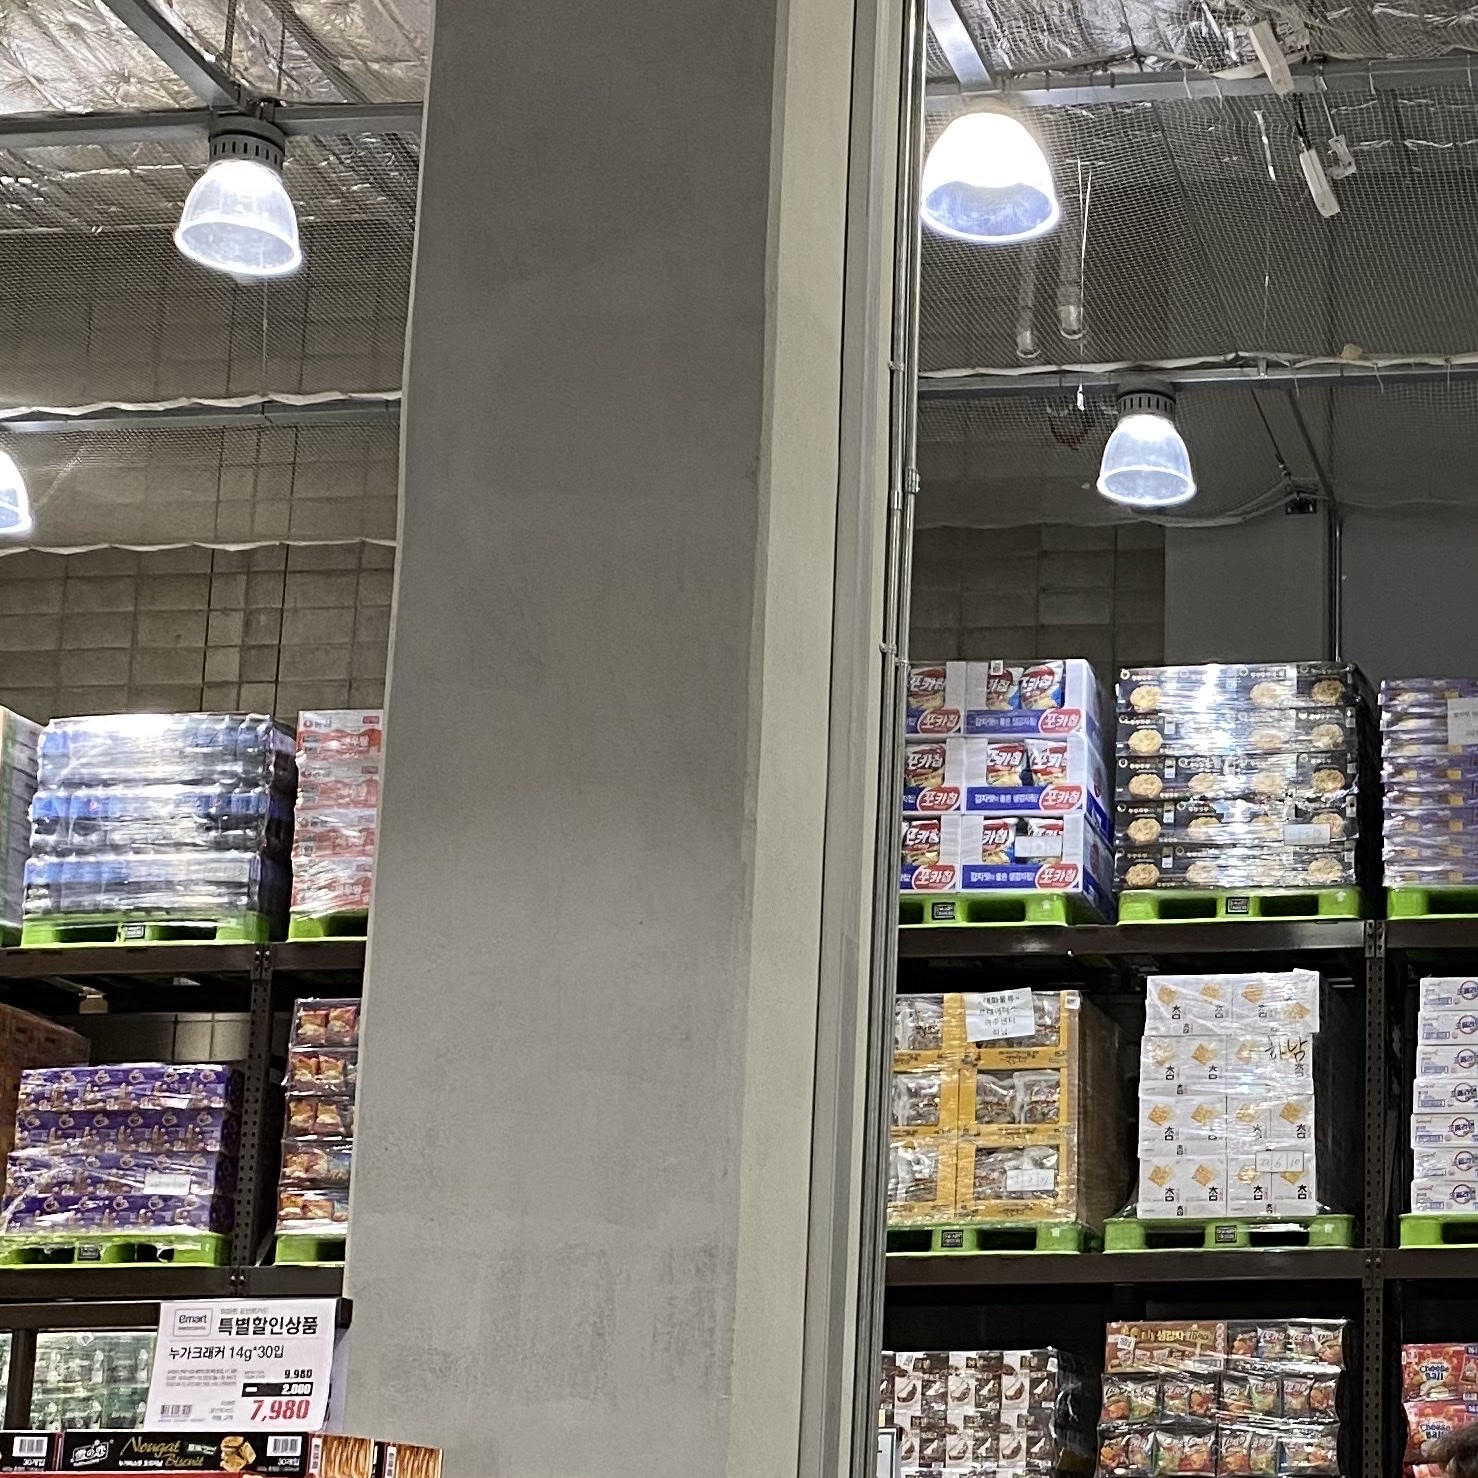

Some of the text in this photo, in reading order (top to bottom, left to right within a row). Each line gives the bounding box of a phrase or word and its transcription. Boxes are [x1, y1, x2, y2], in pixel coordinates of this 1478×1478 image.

[1042, 713, 1080, 728] 포카칩
[921, 791, 958, 806] 포카칩
[1042, 790, 1080, 805] 포카칩
[916, 870, 953, 884] 포카칩
[1038, 869, 1076, 884] 포카칩
[218, 1316, 318, 1336] 특별할인상품
[168, 1346, 226, 1360] 누가크래커
[1419, 1364, 1450, 1375] Cheese
[1425, 1371, 1444, 1381] Ball
[250, 1400, 311, 1422] 7,980
[119, 1436, 181, 1456] Nougat
[165, 1453, 205, 1467] Biscuit
